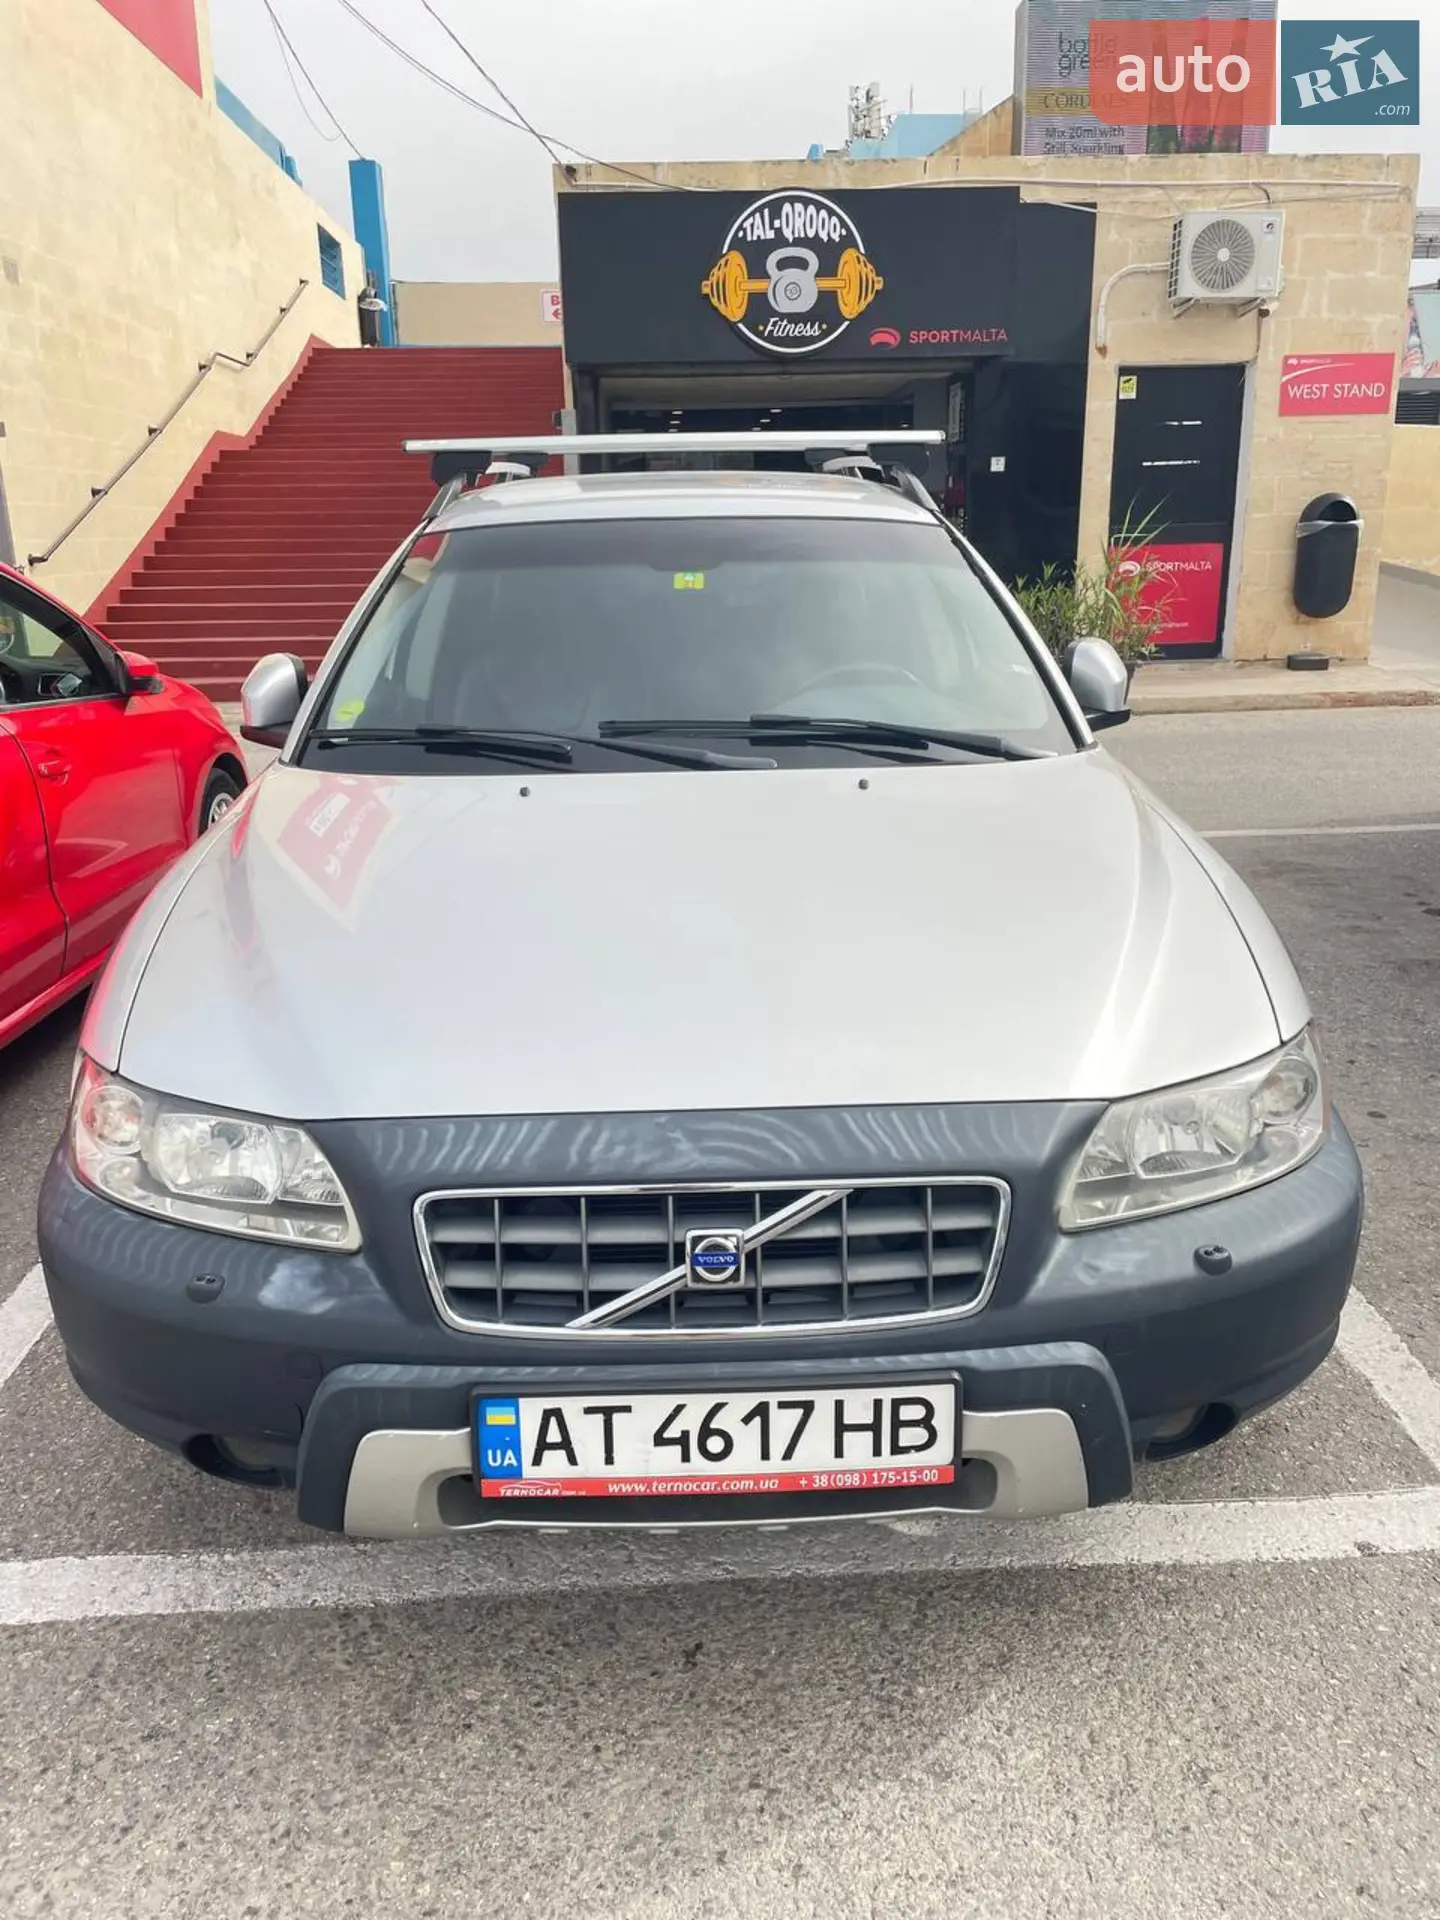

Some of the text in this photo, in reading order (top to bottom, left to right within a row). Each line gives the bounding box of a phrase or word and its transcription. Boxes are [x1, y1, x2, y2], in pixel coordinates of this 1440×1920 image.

[743, 202, 840, 243] TAL-QROQQ
[764, 317, 821, 336] Fitness
[909, 328, 1007, 343] SPORTMALTA
[1287, 382, 1385, 399] WEST STAND
[697, 1255, 735, 1263] VOLVO
[531, 1397, 938, 1466] AT 4617 HB
[487, 1449, 518, 1466] UA
[872, 1468, 939, 1484] 175-15-00
[608, 1478, 779, 1494] www.ternocar.com.ua
